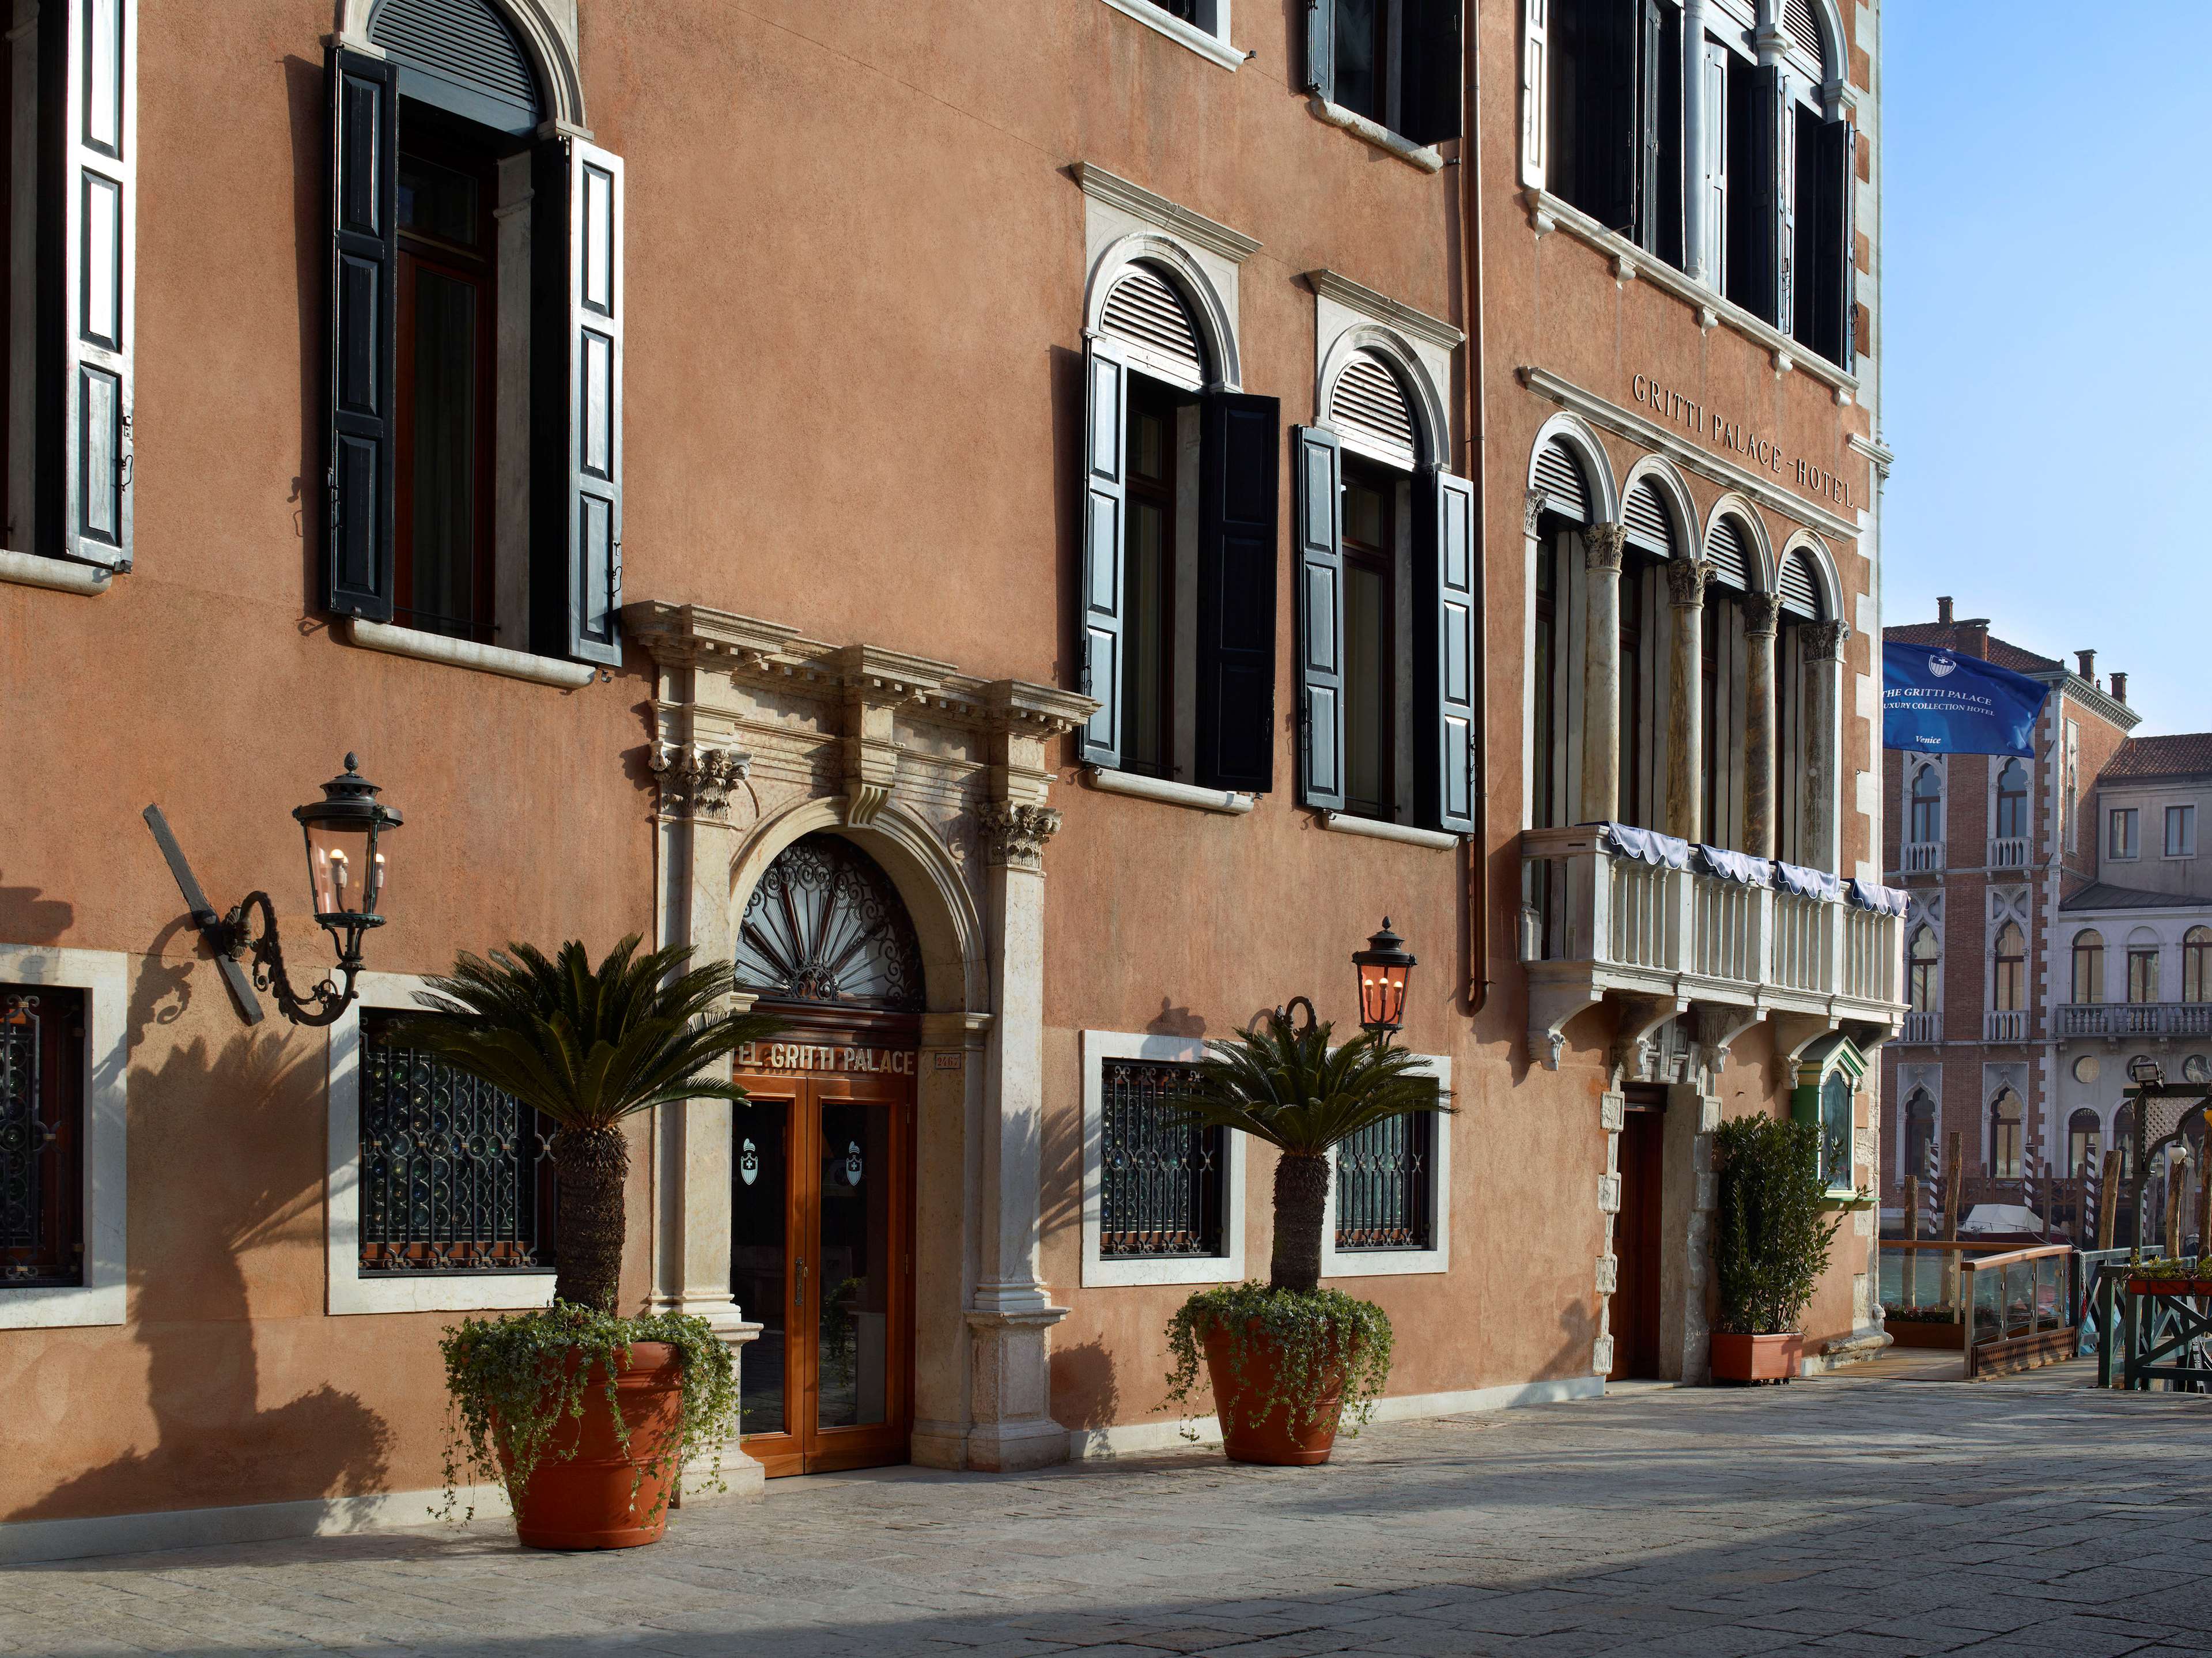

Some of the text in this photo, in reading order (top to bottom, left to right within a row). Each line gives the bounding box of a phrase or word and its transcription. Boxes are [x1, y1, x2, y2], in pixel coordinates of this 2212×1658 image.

[1633, 374, 1703, 432] GRITTI
[1882, 688, 1992, 705] THE GRITTI PALACE
[1912, 703, 1965, 711] COLLECTION
[1967, 705, 1995, 716] HOTEL
[1915, 736, 1941, 744] Venice
[771, 1043, 834, 1070] GRITTI
[844, 1047, 915, 1075] PALACE
